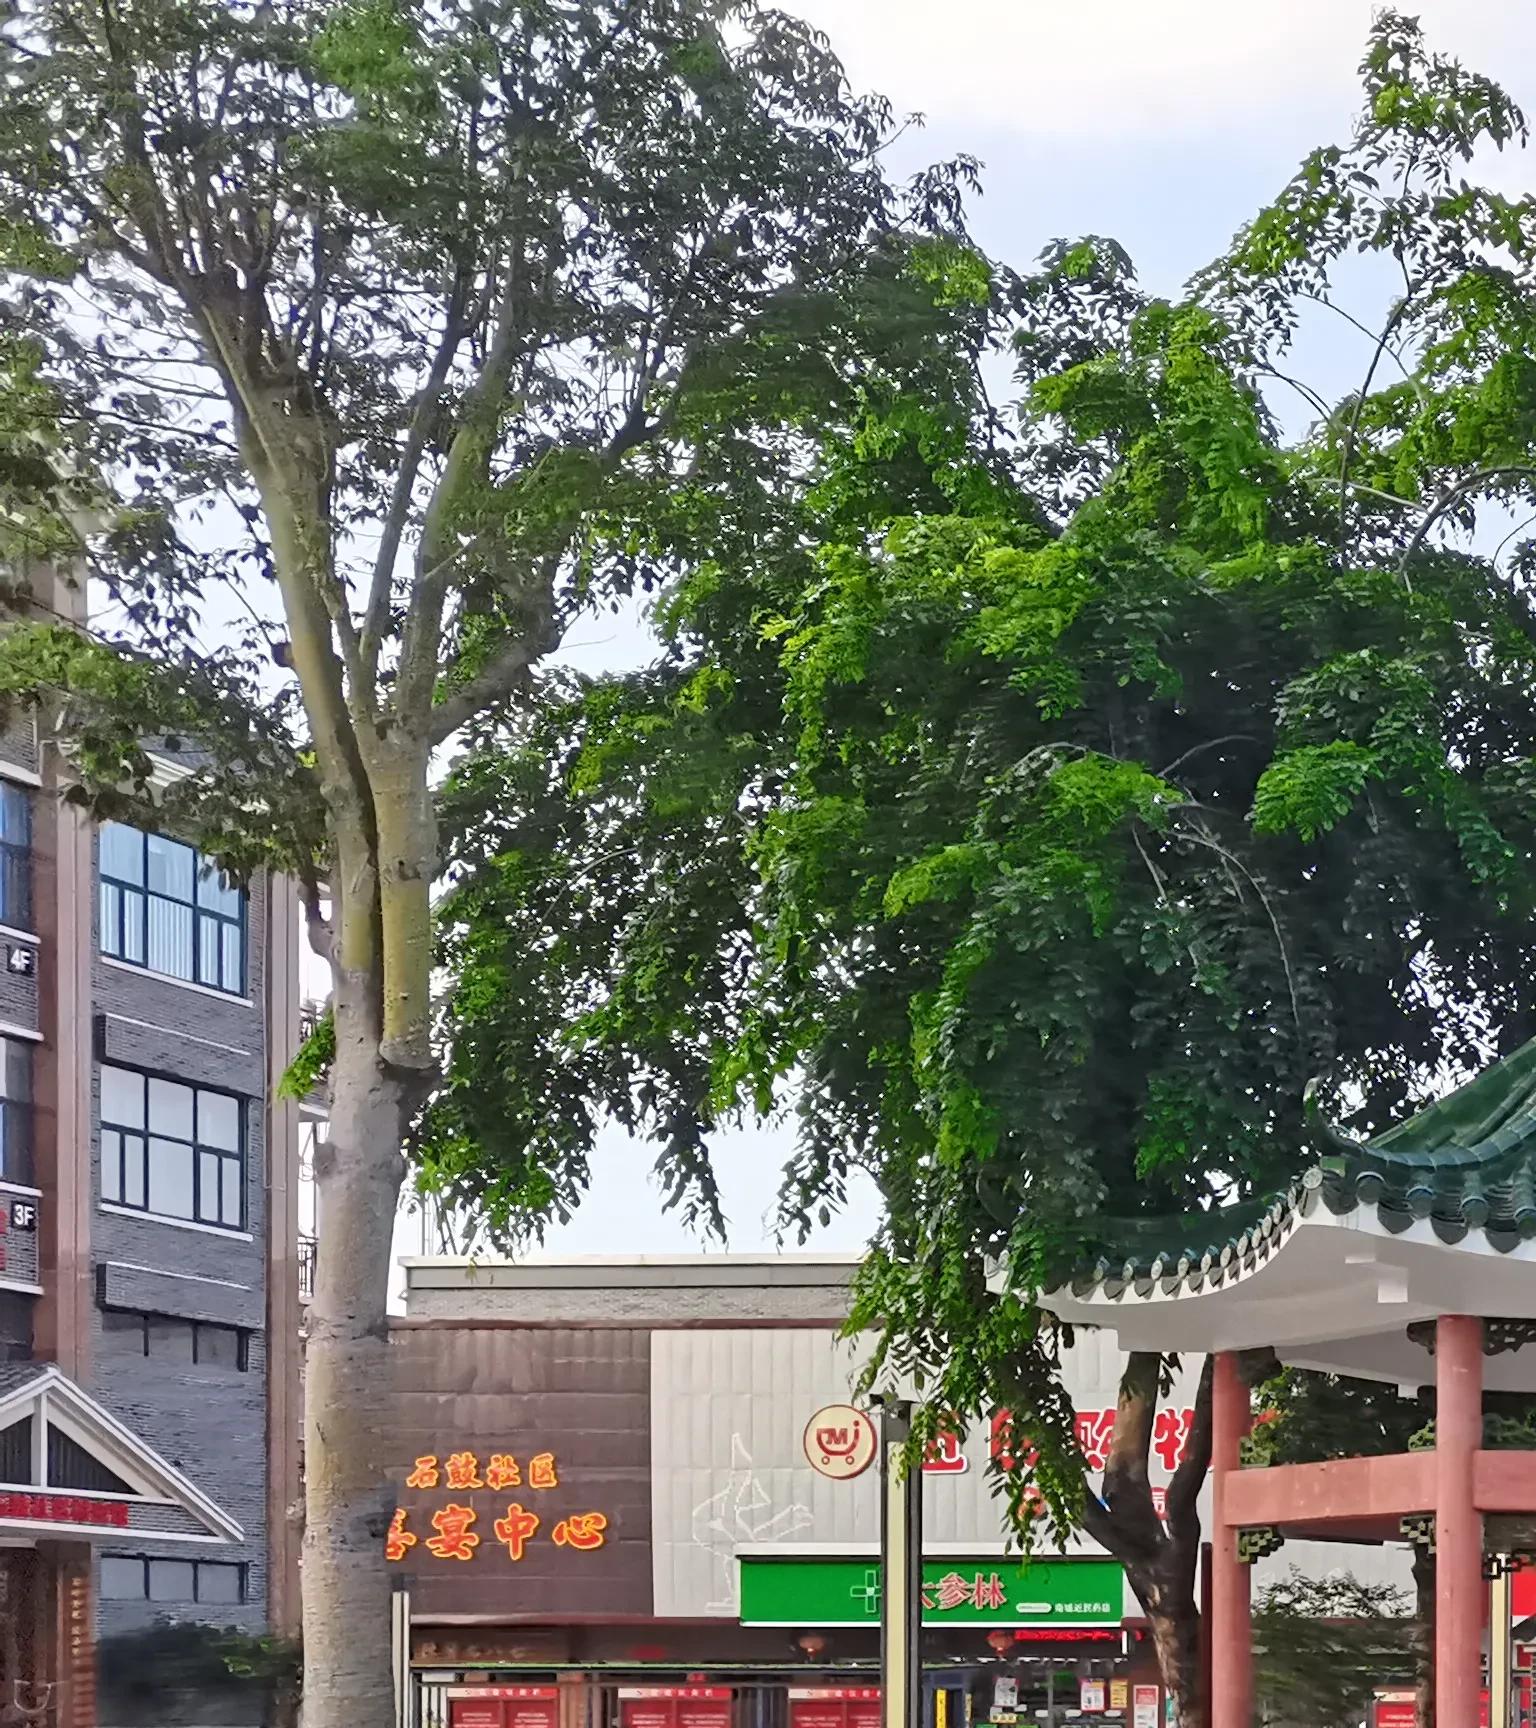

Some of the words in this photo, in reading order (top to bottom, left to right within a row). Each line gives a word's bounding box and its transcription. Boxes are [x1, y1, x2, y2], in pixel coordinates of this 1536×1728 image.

[9, 949, 31, 971] 4F
[13, 1204, 34, 1226] 3F
[406, 1452, 557, 1490] 石鼓社区
